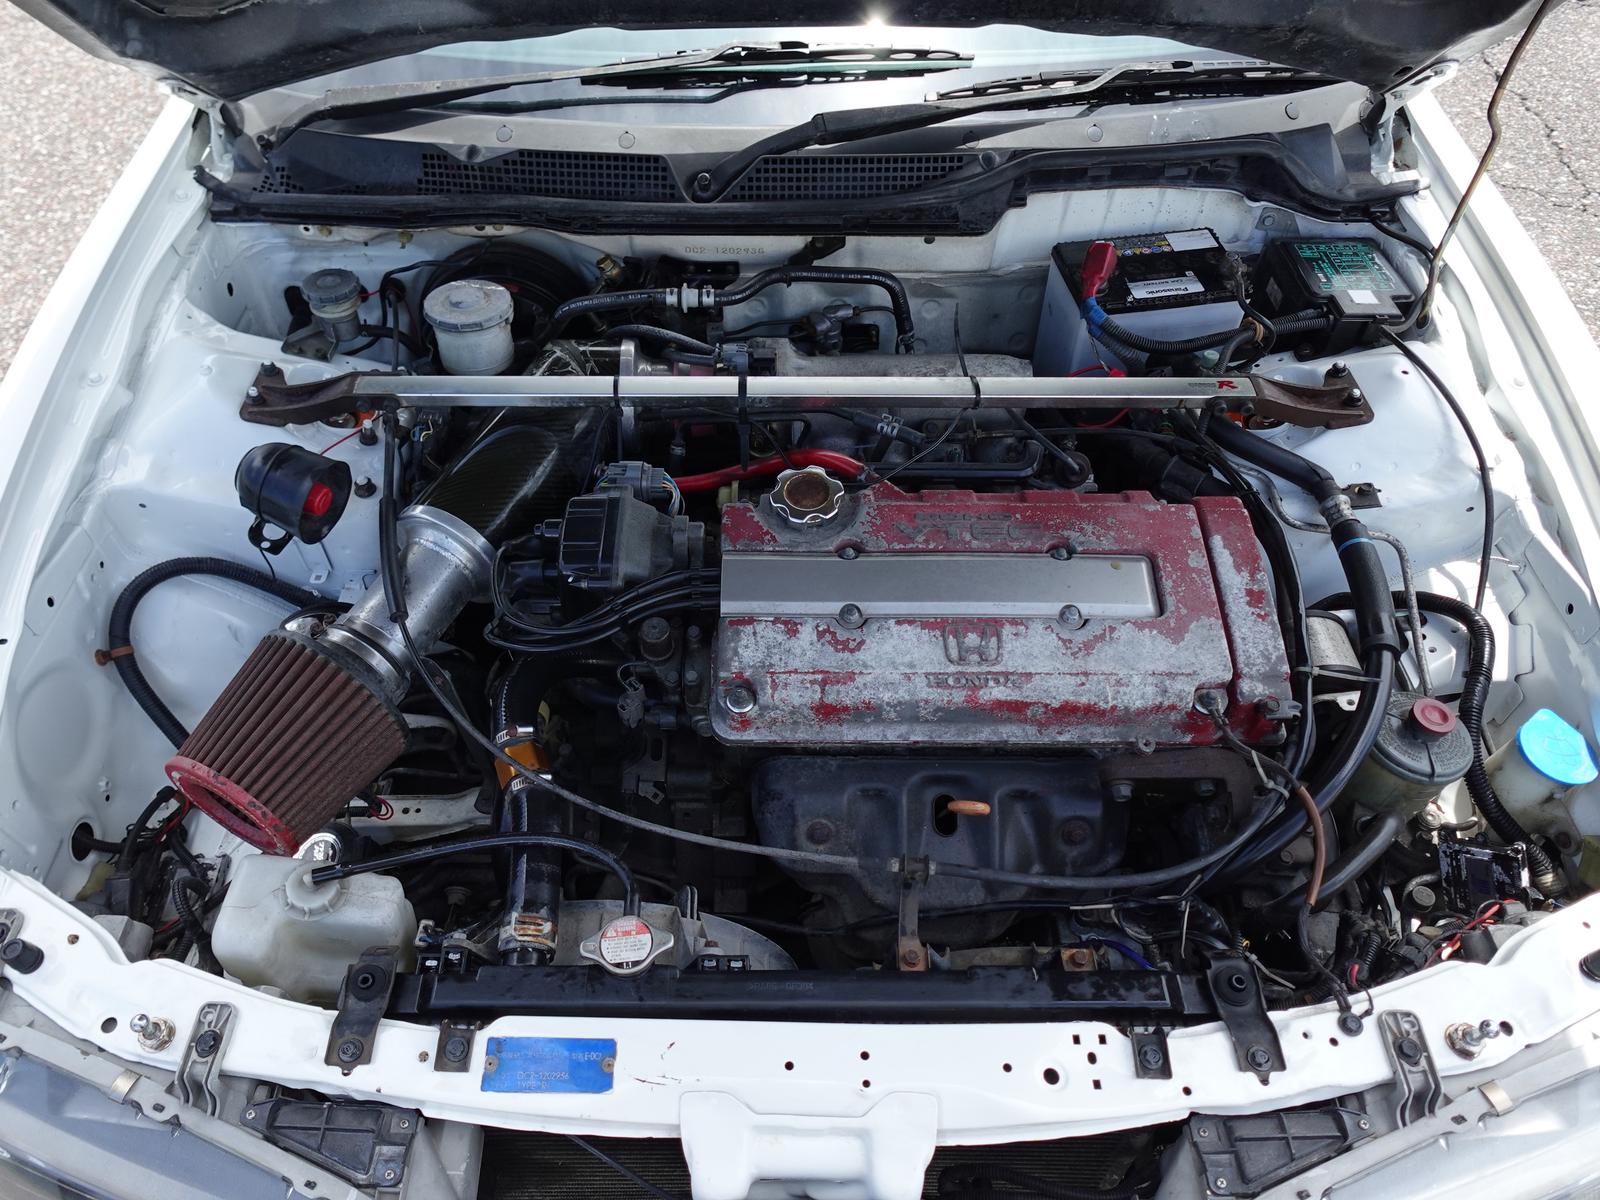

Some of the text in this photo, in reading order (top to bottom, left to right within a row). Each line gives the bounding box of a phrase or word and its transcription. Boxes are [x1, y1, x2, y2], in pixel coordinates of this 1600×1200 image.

[1145, 286, 1189, 296] Panasonic
[892, 522, 1041, 541] VTEC
[923, 673, 1024, 689] HONDA
